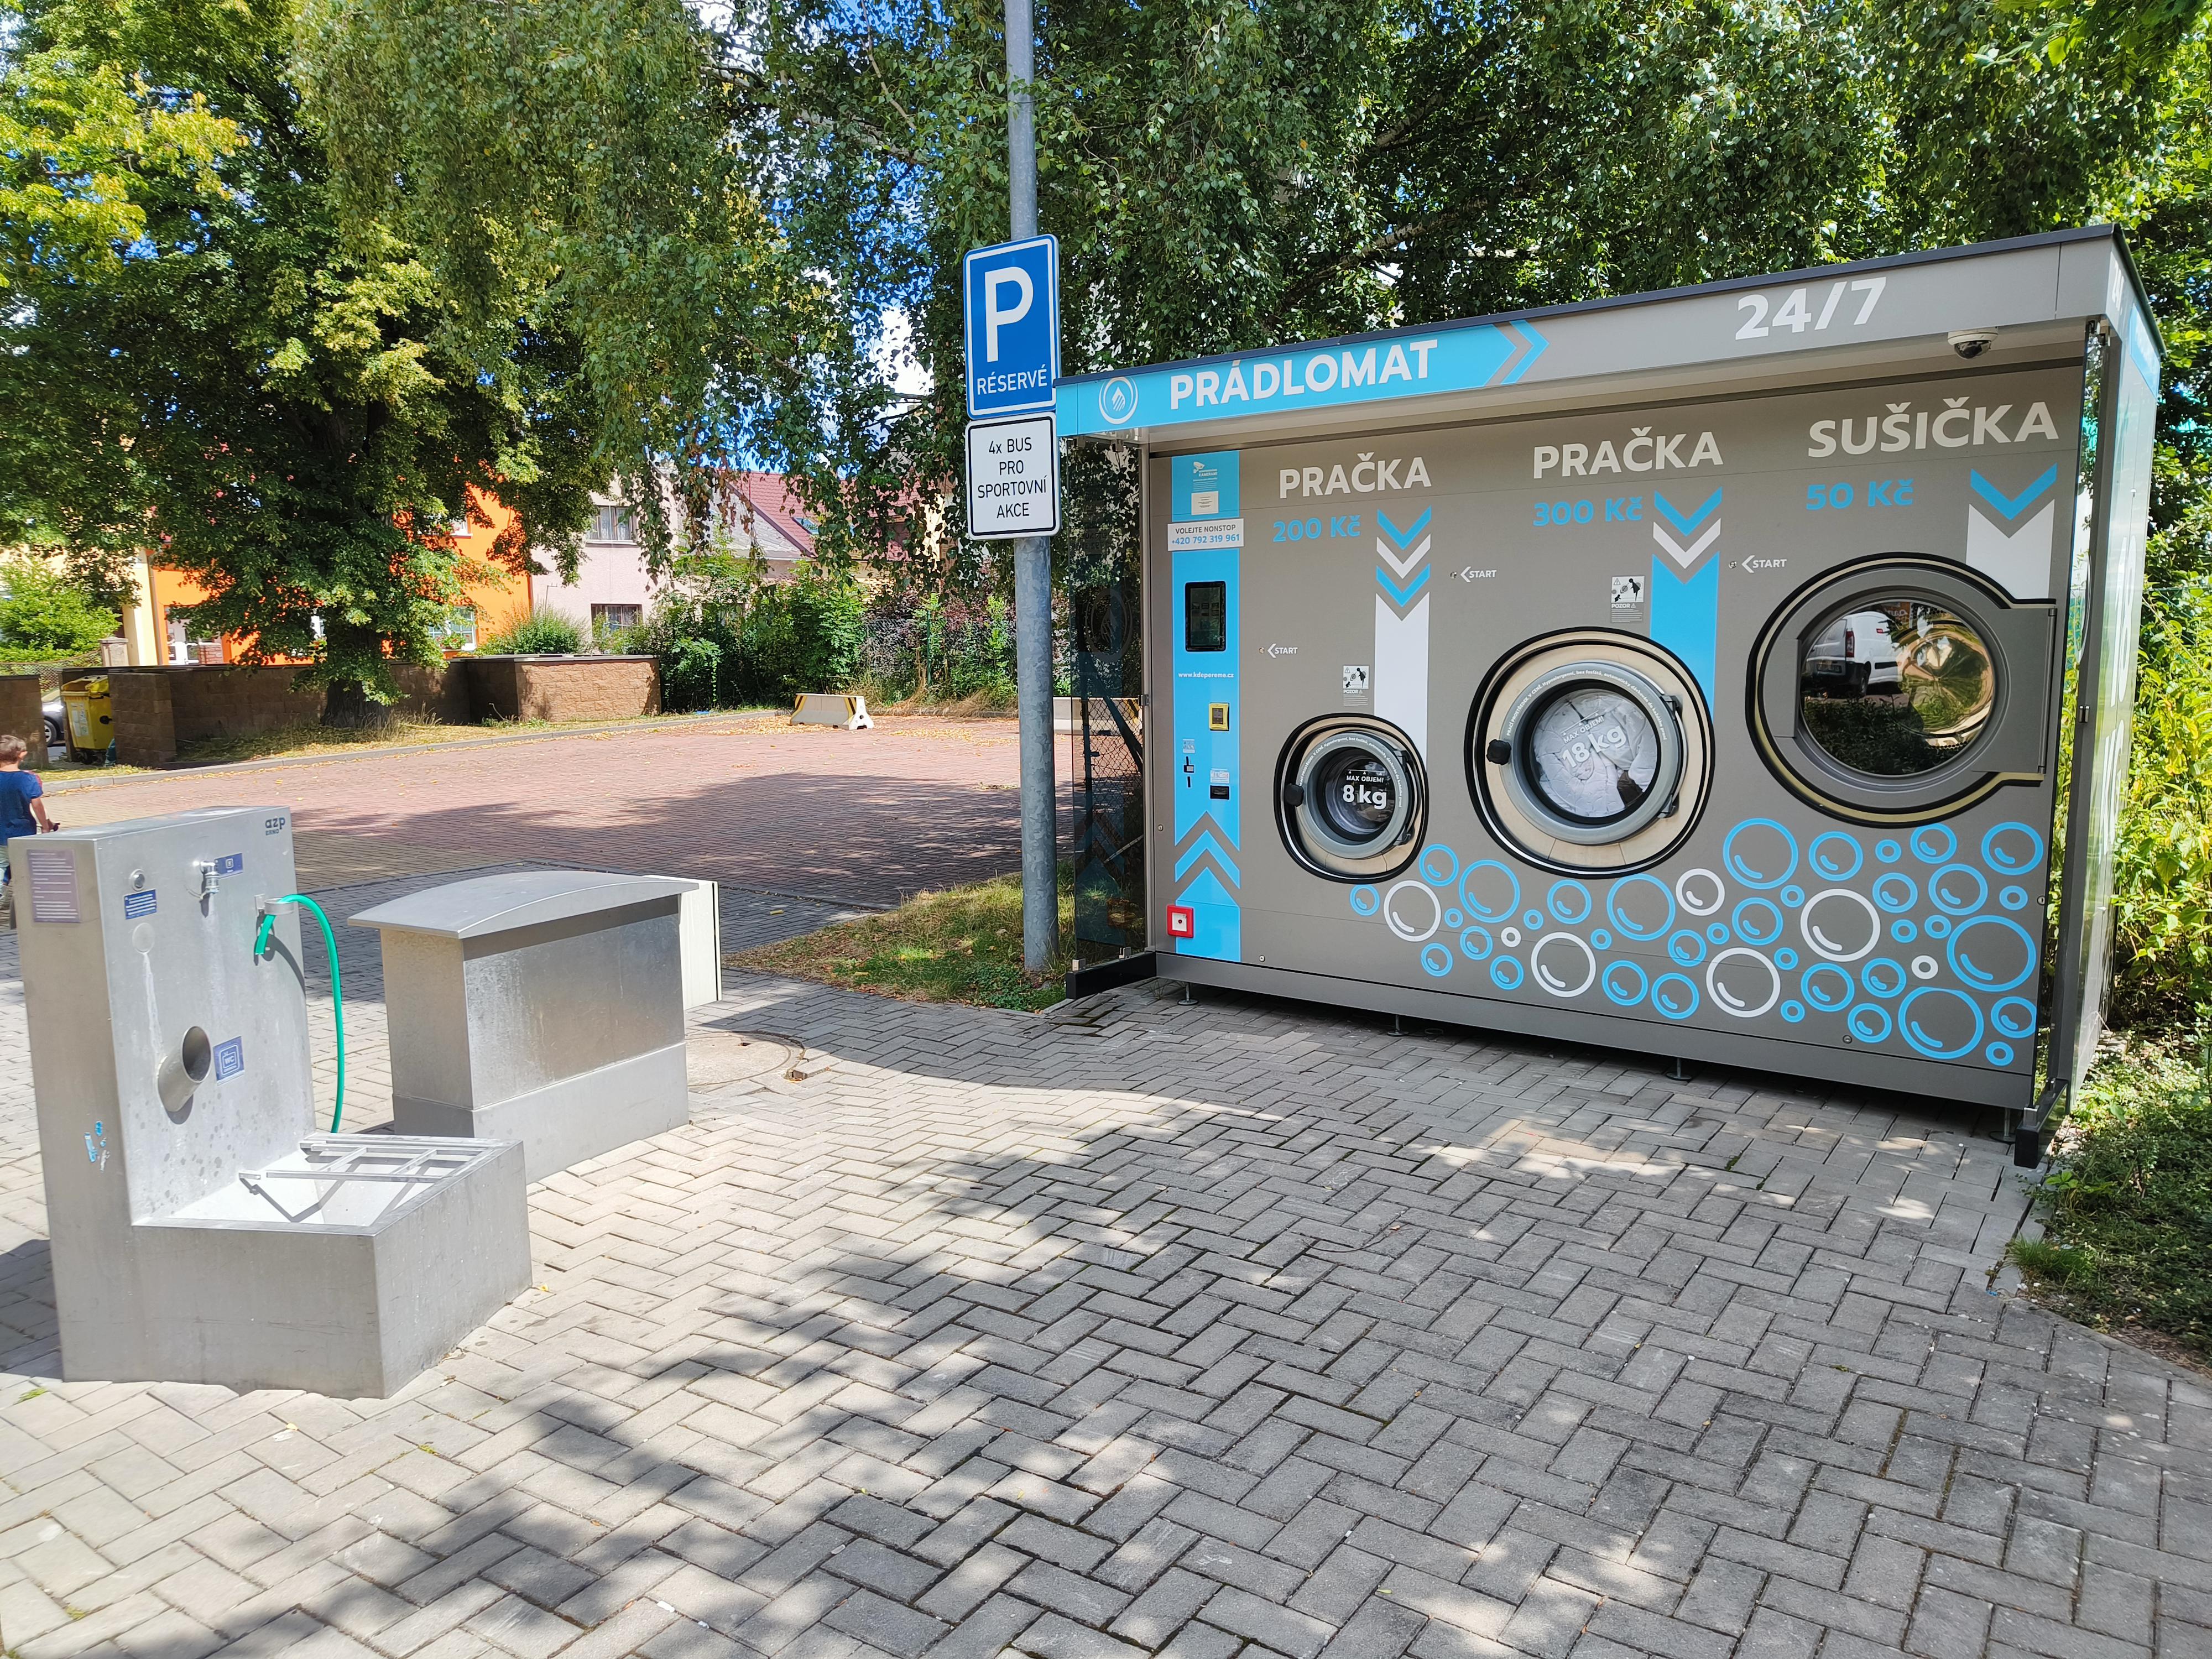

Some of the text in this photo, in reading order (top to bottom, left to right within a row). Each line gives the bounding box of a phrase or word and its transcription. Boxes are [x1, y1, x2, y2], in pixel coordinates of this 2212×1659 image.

[984, 267, 1034, 363] P
[1735, 276, 1887, 340] 24/7
[977, 364, 1047, 395] RÉSERVÉ
[1170, 339, 1437, 409] PRÁDLOMAT
[1807, 396, 2059, 458] SUŠIČKA
[988, 437, 1032, 455] 4x BUS
[1533, 426, 1724, 479] PRAČKA
[999, 460, 1024, 476] PRO
[1280, 452, 1432, 498] PRAČKA
[978, 474, 1047, 499] SPORTOVNÍ
[1806, 478, 1914, 510] 50 Kč
[997, 502, 1030, 519] AKCE
[1533, 496, 1643, 526] 300 Kč
[1204, 524, 1236, 533] NONSTOP
[1273, 514, 1361, 542] 200 Kč
[1469, 570, 1497, 578] START
[1752, 559, 1787, 568] START
[1562, 725, 1626, 768] 18 kg
[1563, 731, 1580, 744] MAX
[1343, 784, 1387, 810] 8 kg
[265, 817, 285, 830] azp
